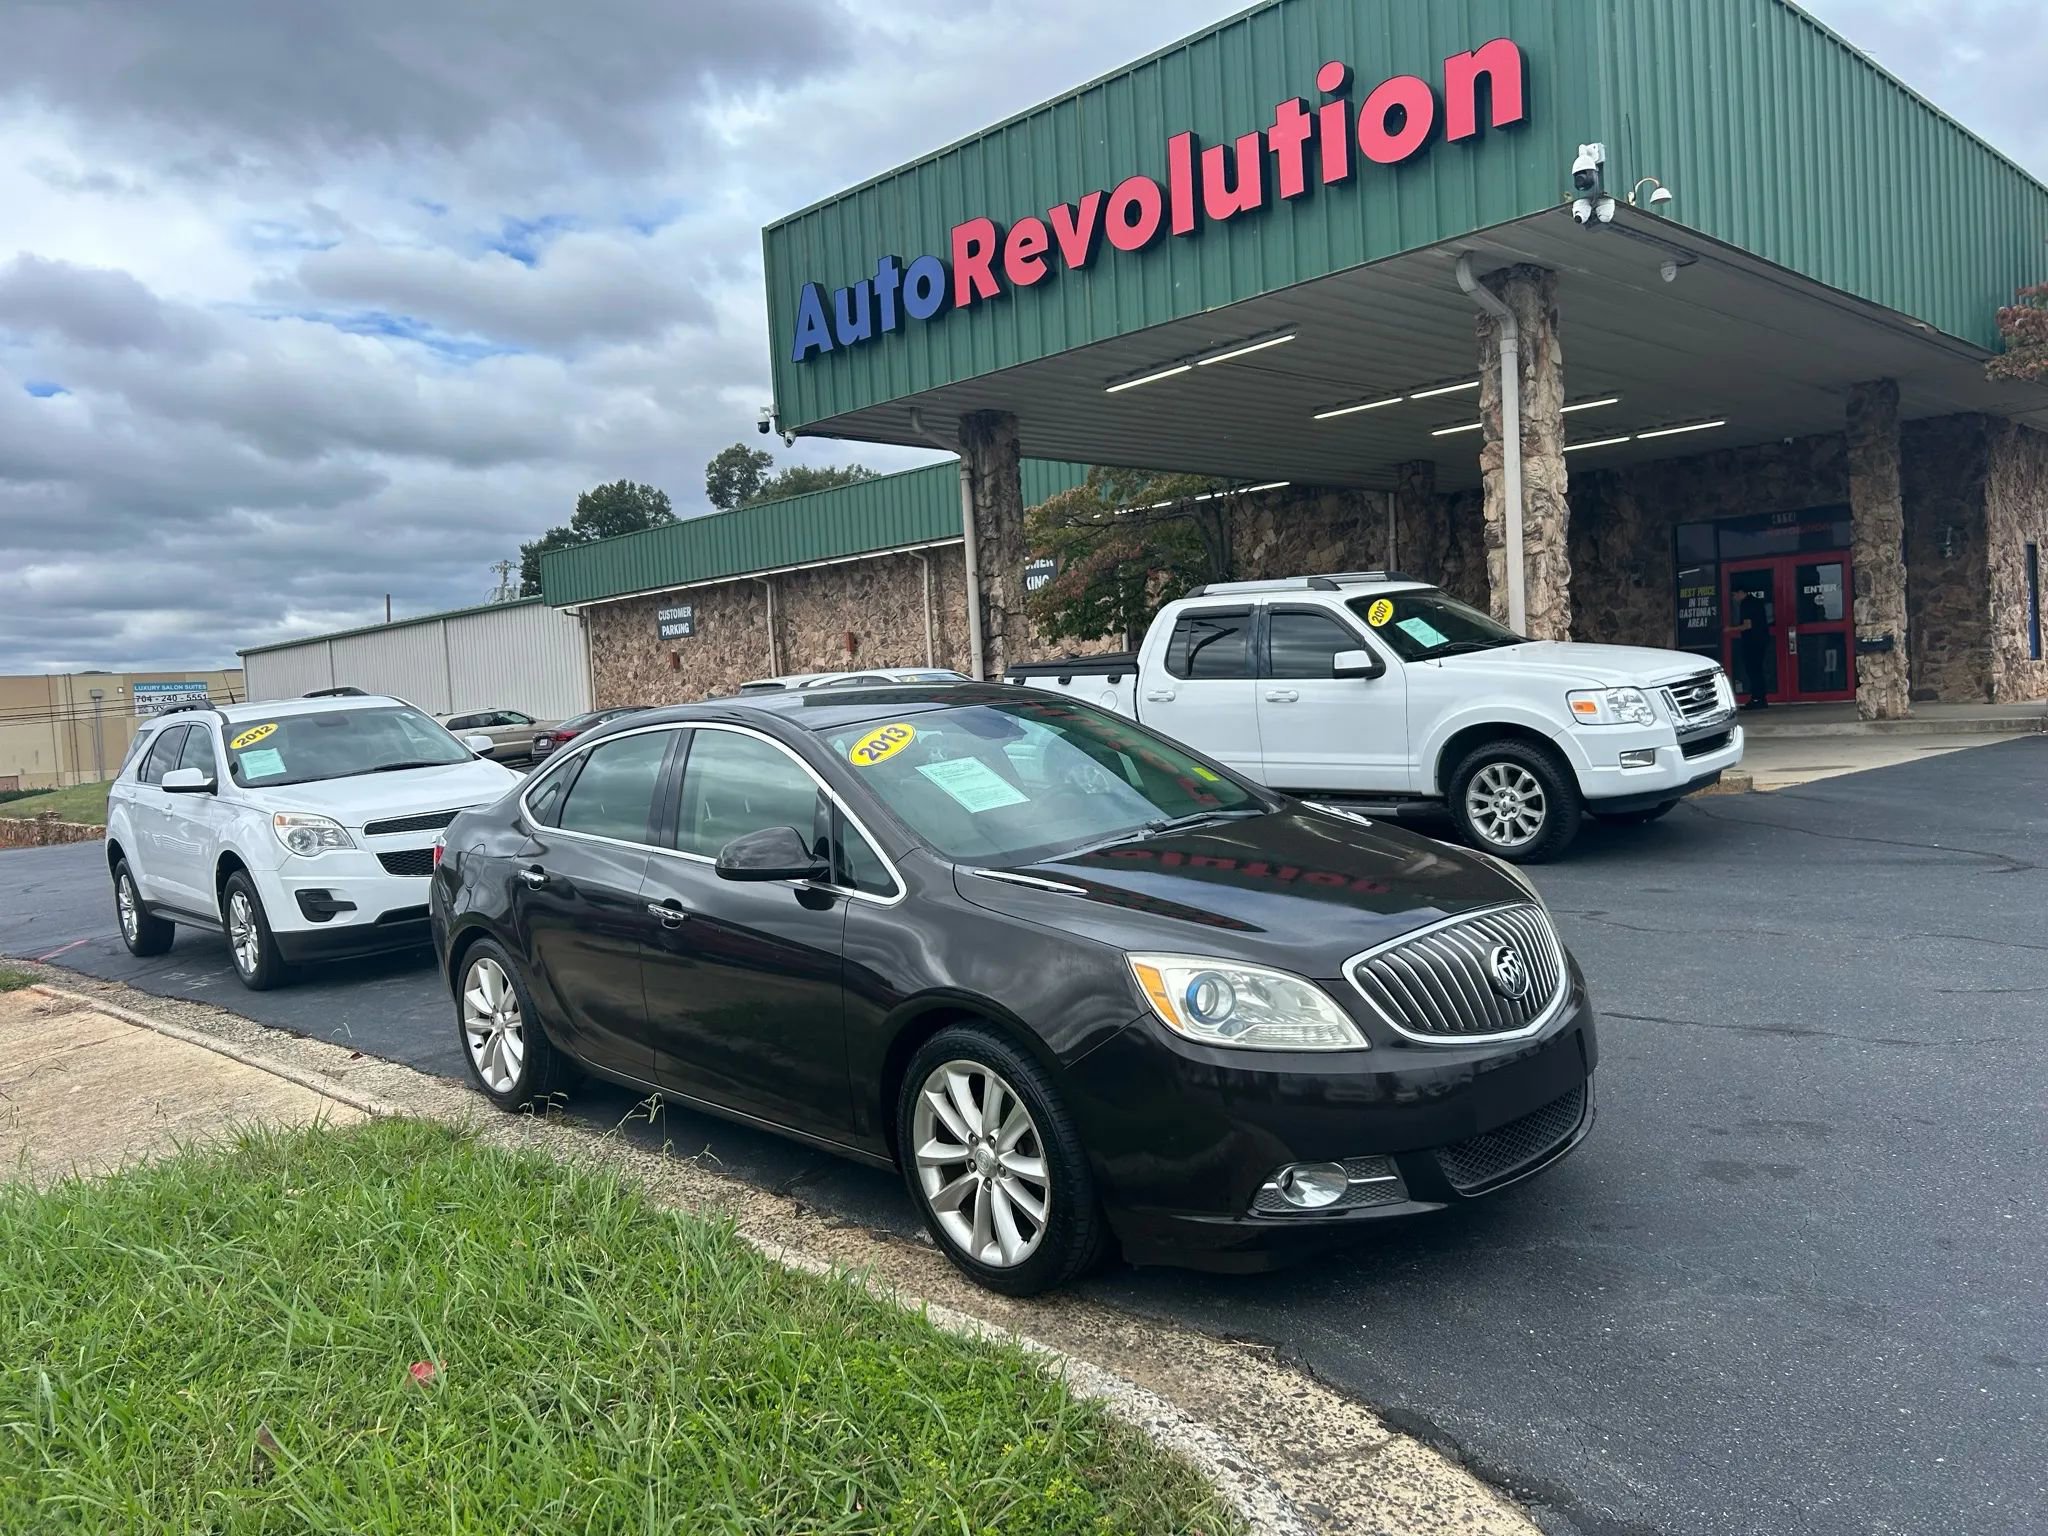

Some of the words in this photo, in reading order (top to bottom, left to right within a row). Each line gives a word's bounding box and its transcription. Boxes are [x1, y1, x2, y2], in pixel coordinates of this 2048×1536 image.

[791, 37, 1525, 363] AutoRevolution
[1803, 583, 1837, 594] ENTER
[1688, 597, 1696, 608] IN
[1697, 596, 1710, 607] THE
[658, 606, 692, 621] CUSTOMER
[1371, 601, 1389, 625] 2007
[661, 622, 690, 637] PARKING
[1687, 617, 1708, 628] AREA!
[135, 695, 152, 703] 704
[161, 694, 177, 702] 240
[186, 693, 207, 701] 5551
[236, 725, 273, 746] 2012
[858, 727, 908, 761] 2013
